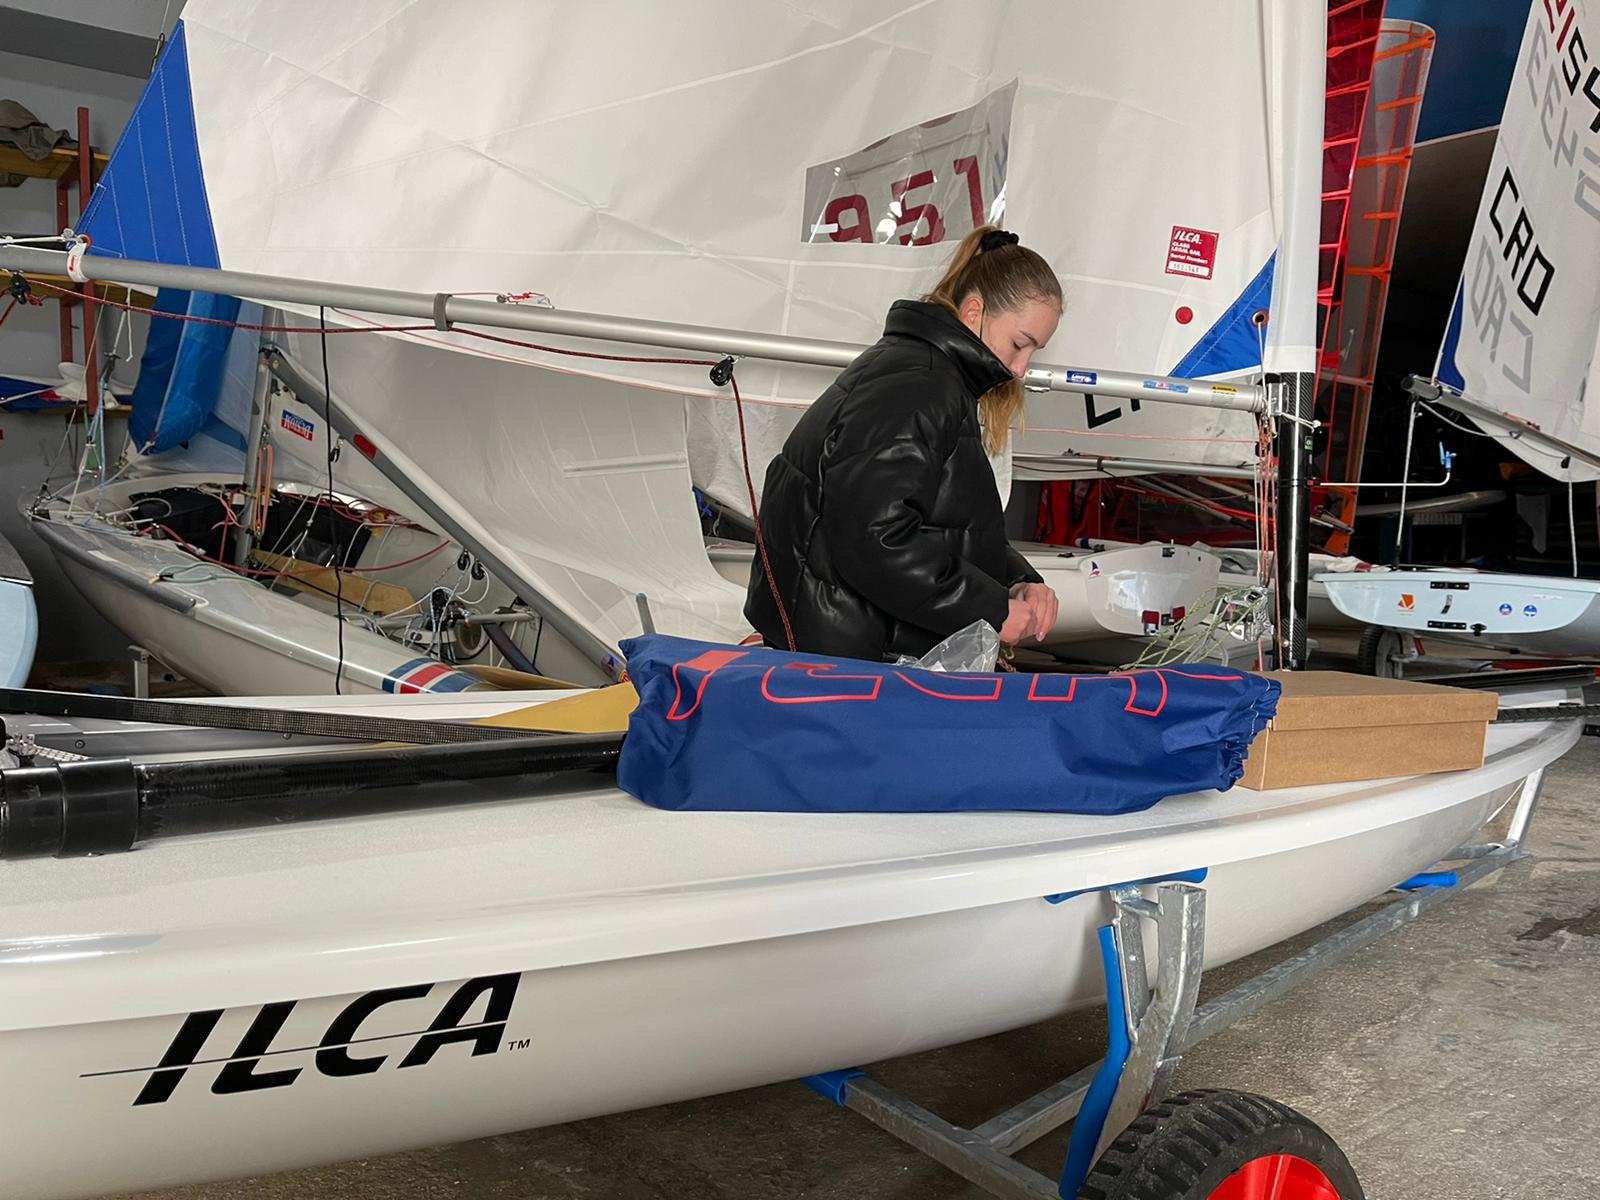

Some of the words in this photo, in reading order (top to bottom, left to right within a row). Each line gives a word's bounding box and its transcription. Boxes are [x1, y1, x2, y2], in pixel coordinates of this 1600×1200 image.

[1174, 230, 1200, 244] ILCA
[1490, 165, 1556, 317] CRO
[132, 971, 522, 1106] ILCA
